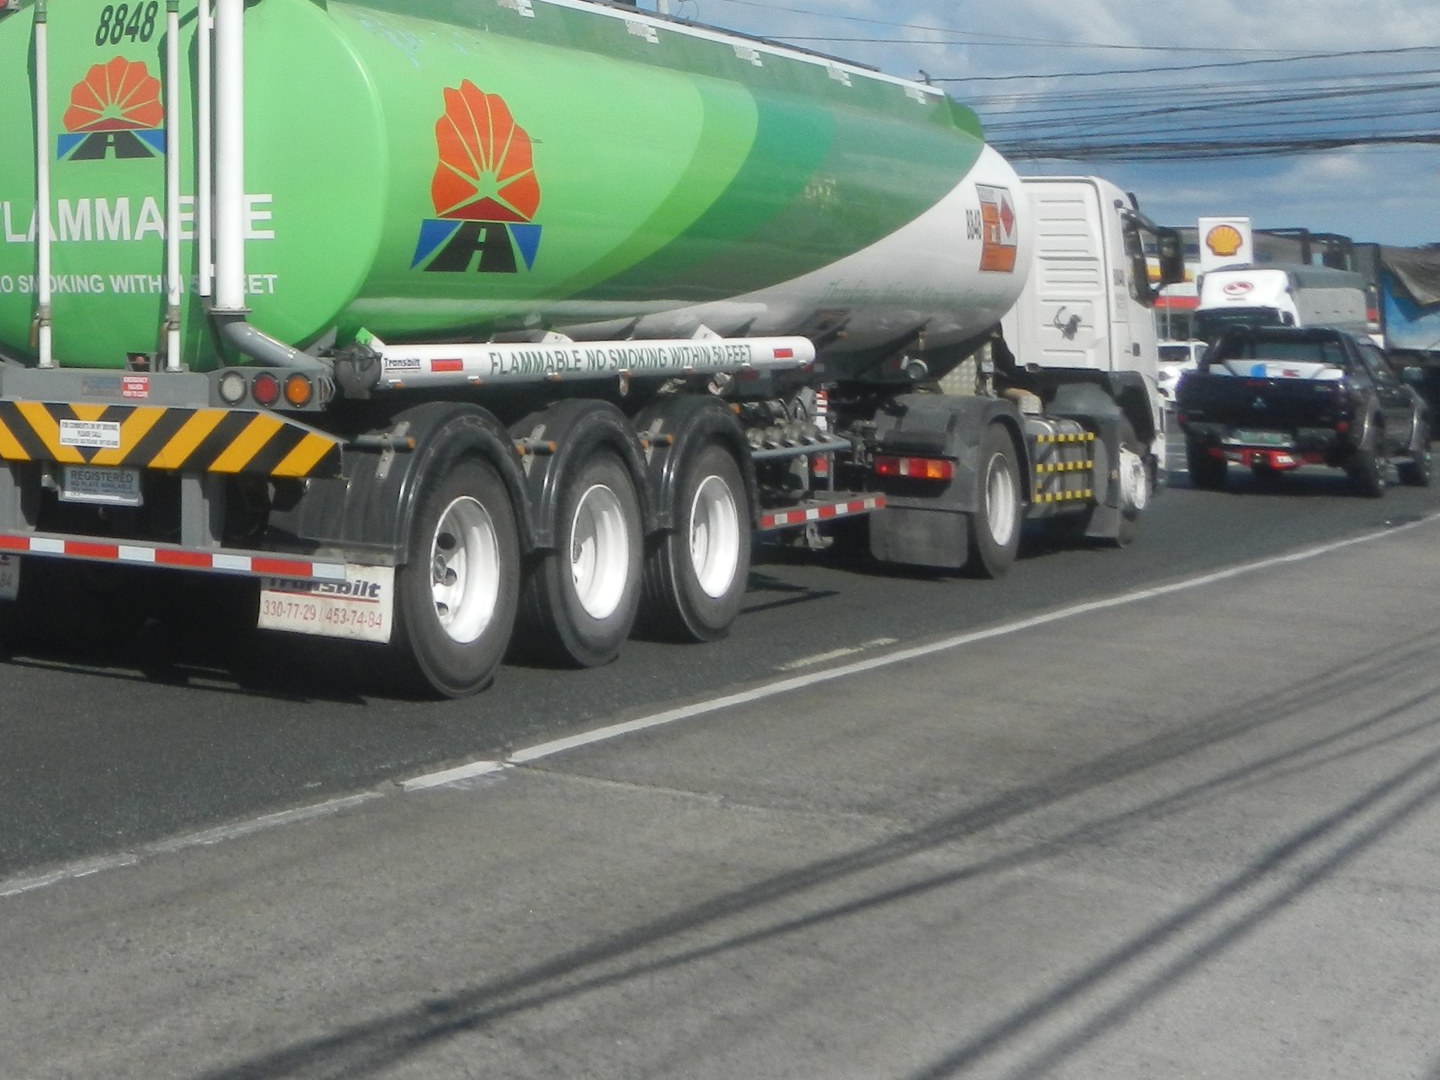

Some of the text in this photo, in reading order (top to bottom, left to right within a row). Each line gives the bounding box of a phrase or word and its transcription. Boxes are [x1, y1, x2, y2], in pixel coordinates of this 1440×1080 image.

[95, 1, 158, 46] 8848
[488, 345, 752, 375] FLAMMABLE NO SMOKING WITHIN 50 FEET
[71, 470, 133, 483] REGISTERED
[263, 600, 316, 621] 330-77-29
[325, 607, 382, 630] 453-74-84
